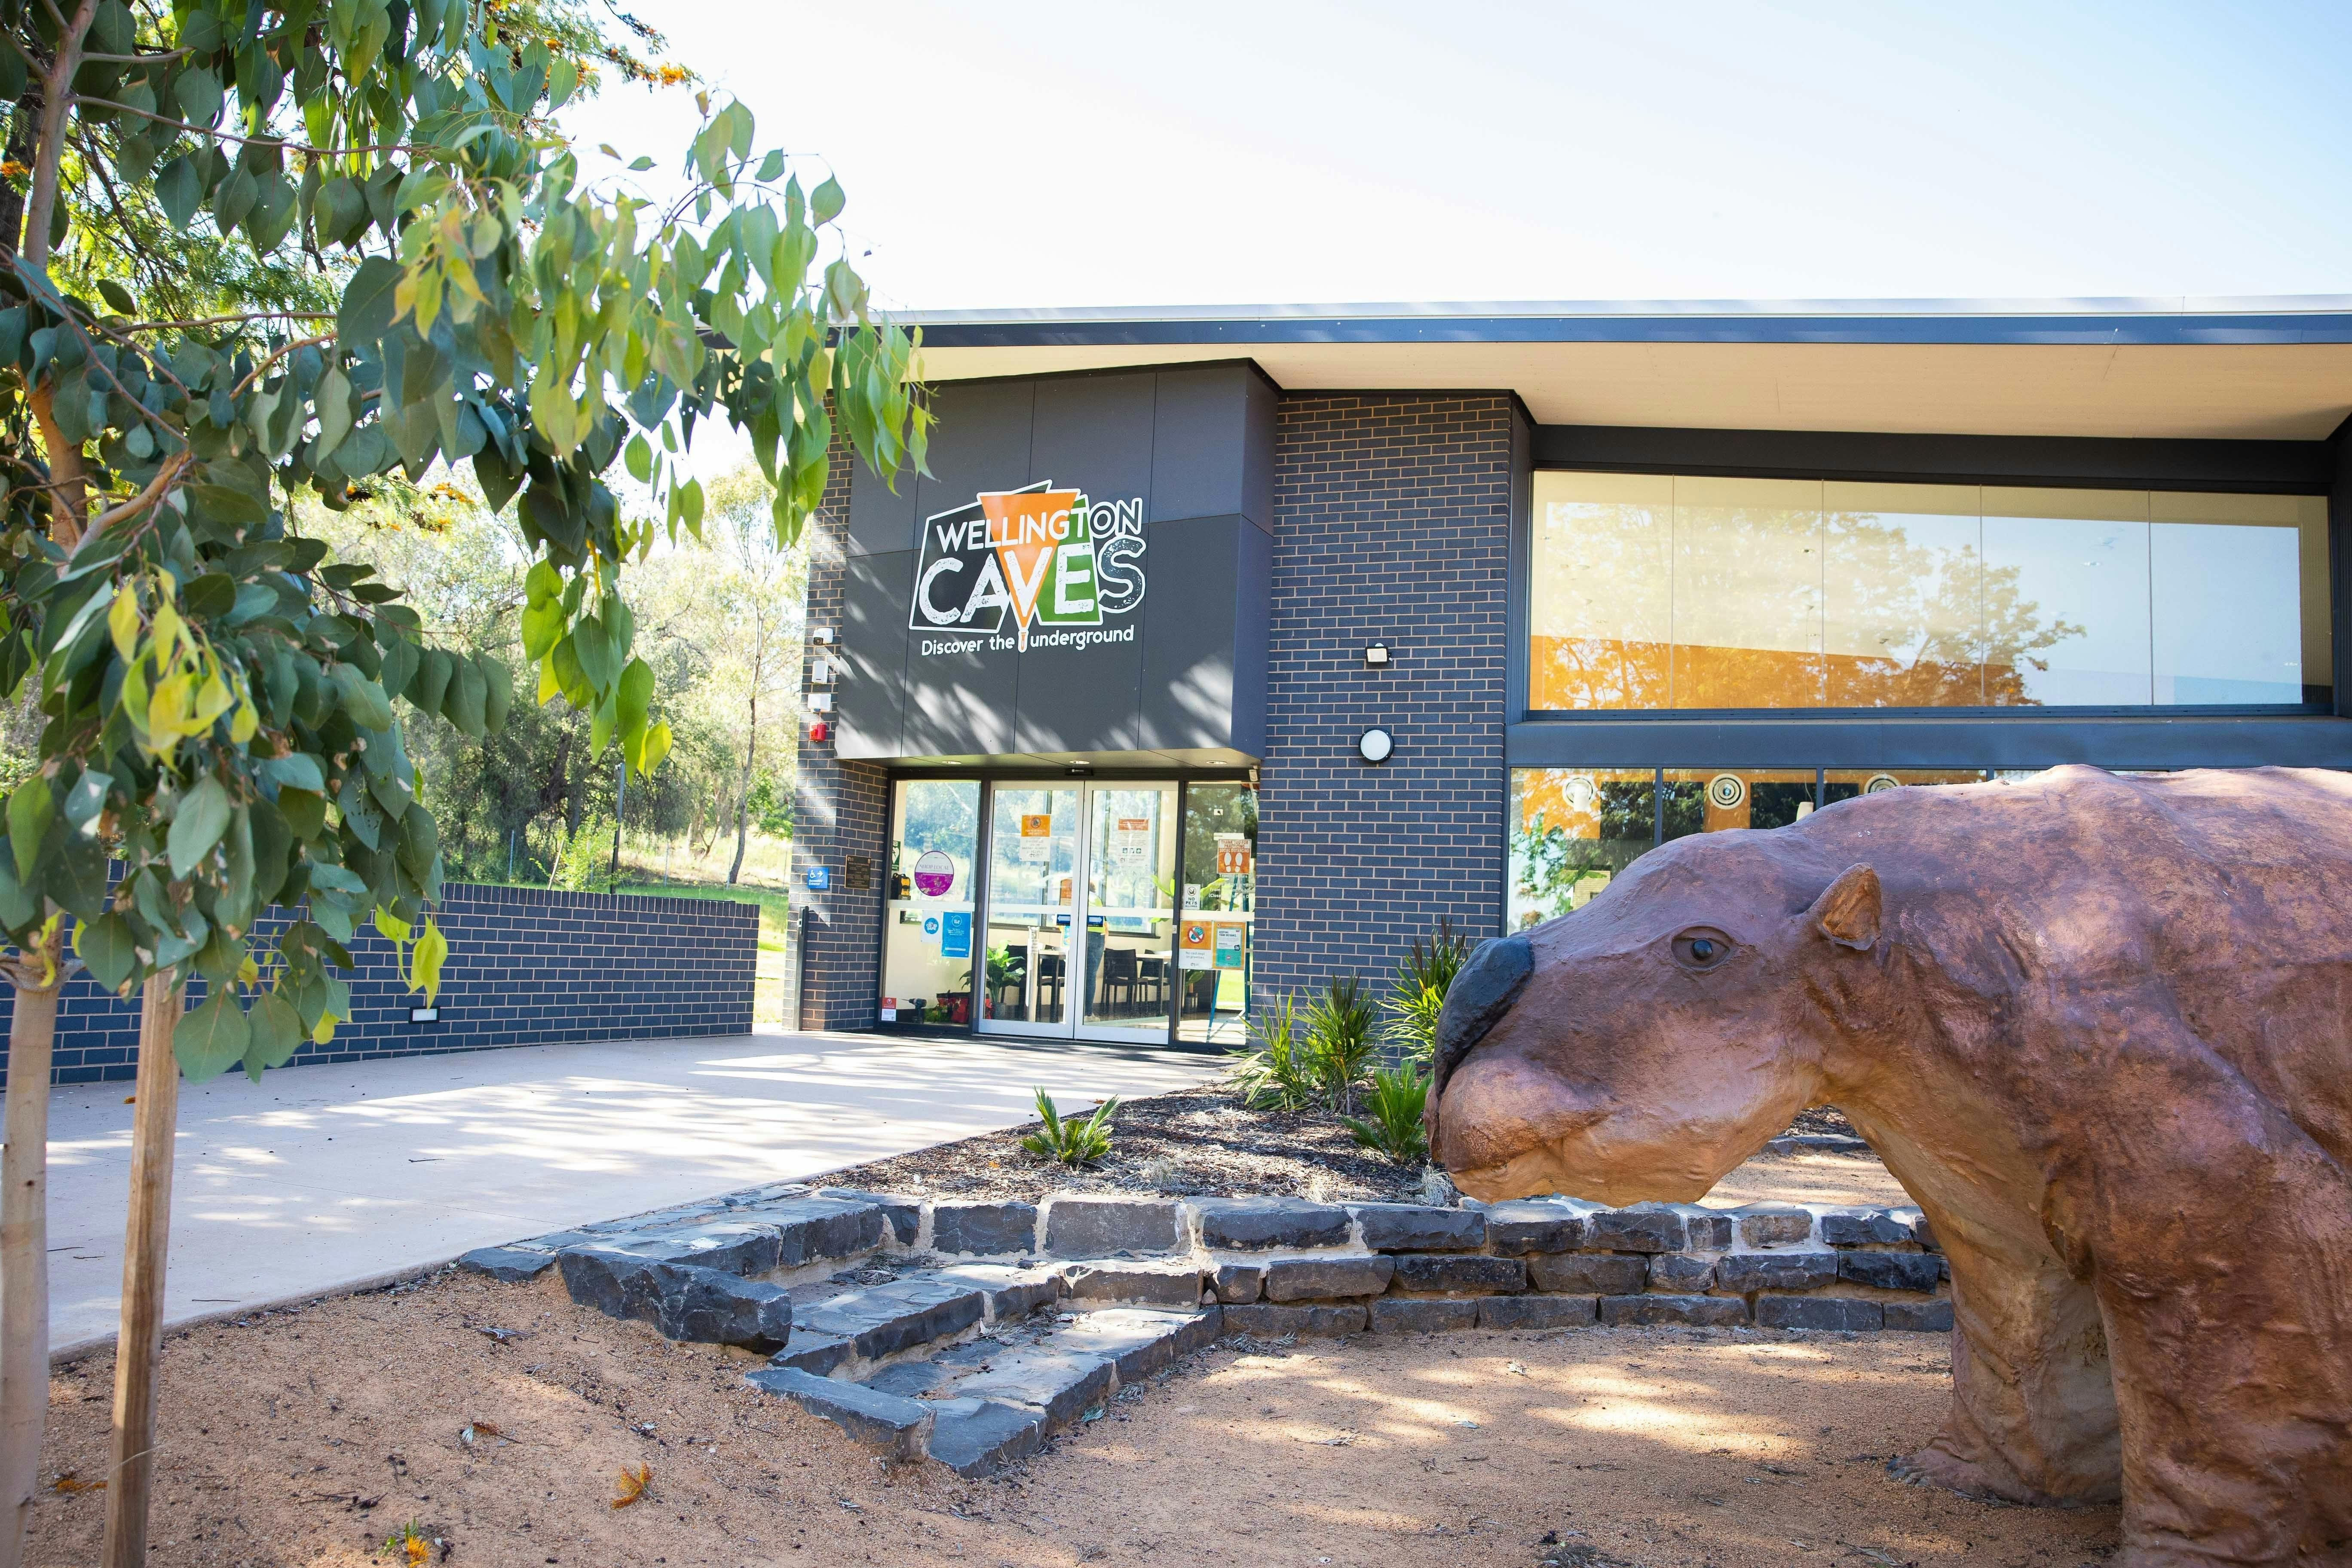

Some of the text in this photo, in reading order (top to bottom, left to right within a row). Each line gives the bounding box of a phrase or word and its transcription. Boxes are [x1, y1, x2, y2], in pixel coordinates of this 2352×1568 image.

[936, 497, 1143, 553] WELLINGTON
[919, 534, 1146, 625] CAVES
[921, 625, 1135, 656] Discover the underground
